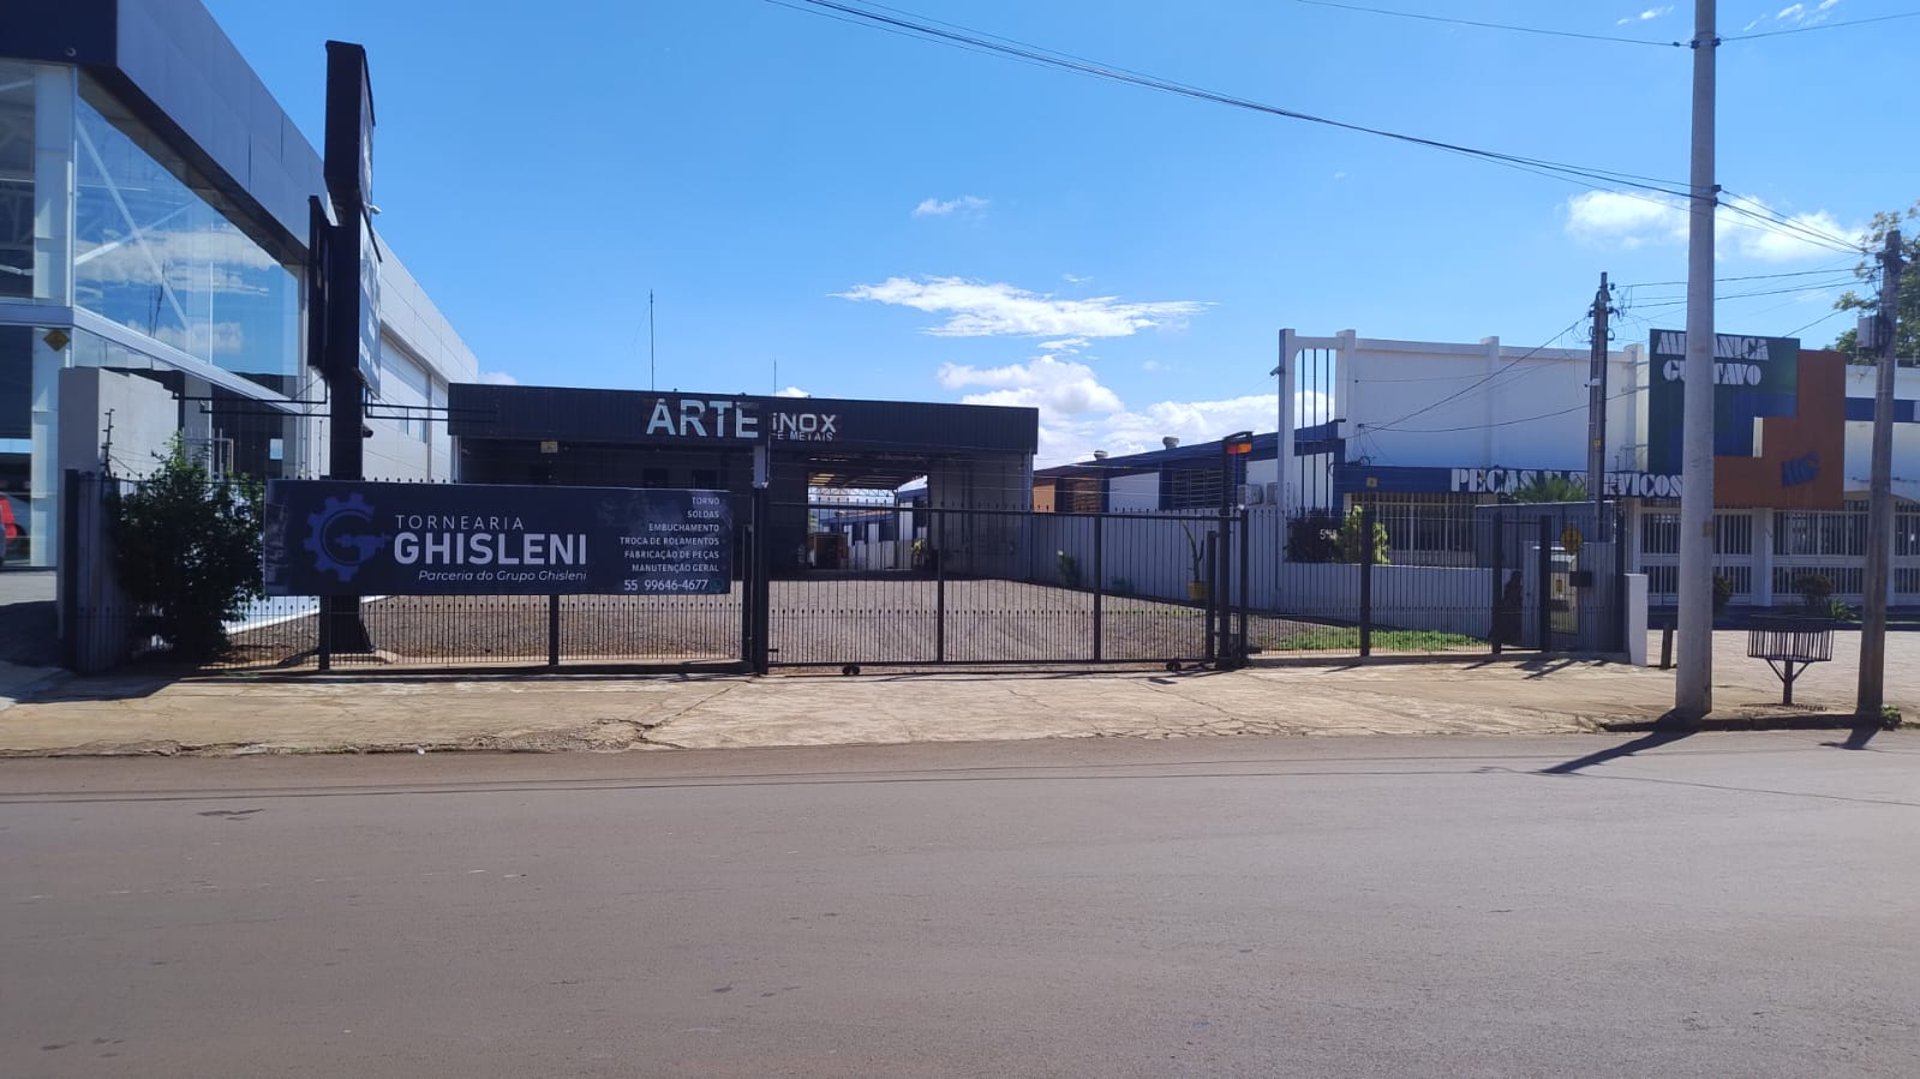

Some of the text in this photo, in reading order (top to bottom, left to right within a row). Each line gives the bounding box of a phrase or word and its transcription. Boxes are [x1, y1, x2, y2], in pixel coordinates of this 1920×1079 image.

[1656, 332, 1769, 360] MNICA
[1663, 360, 1761, 385] GTAVO
[646, 398, 758, 438] ARTE
[692, 497, 720, 505] TORNO
[687, 510, 720, 518] SOLDAS
[395, 515, 524, 530] TORNEARIA
[648, 523, 720, 531] EMBUCHAMENTO
[620, 537, 720, 545] TROCA DE ROLAMENTOS
[394, 532, 587, 565] GHISLENI
[624, 549, 720, 560] FABRICAÇÃO DE PEÇAS
[632, 562, 720, 573] MANUTENÇÃO GERAL
[418, 570, 587, 583] Parceria do Grupo Ghisleni
[624, 579, 709, 591] 55 99646-4677
